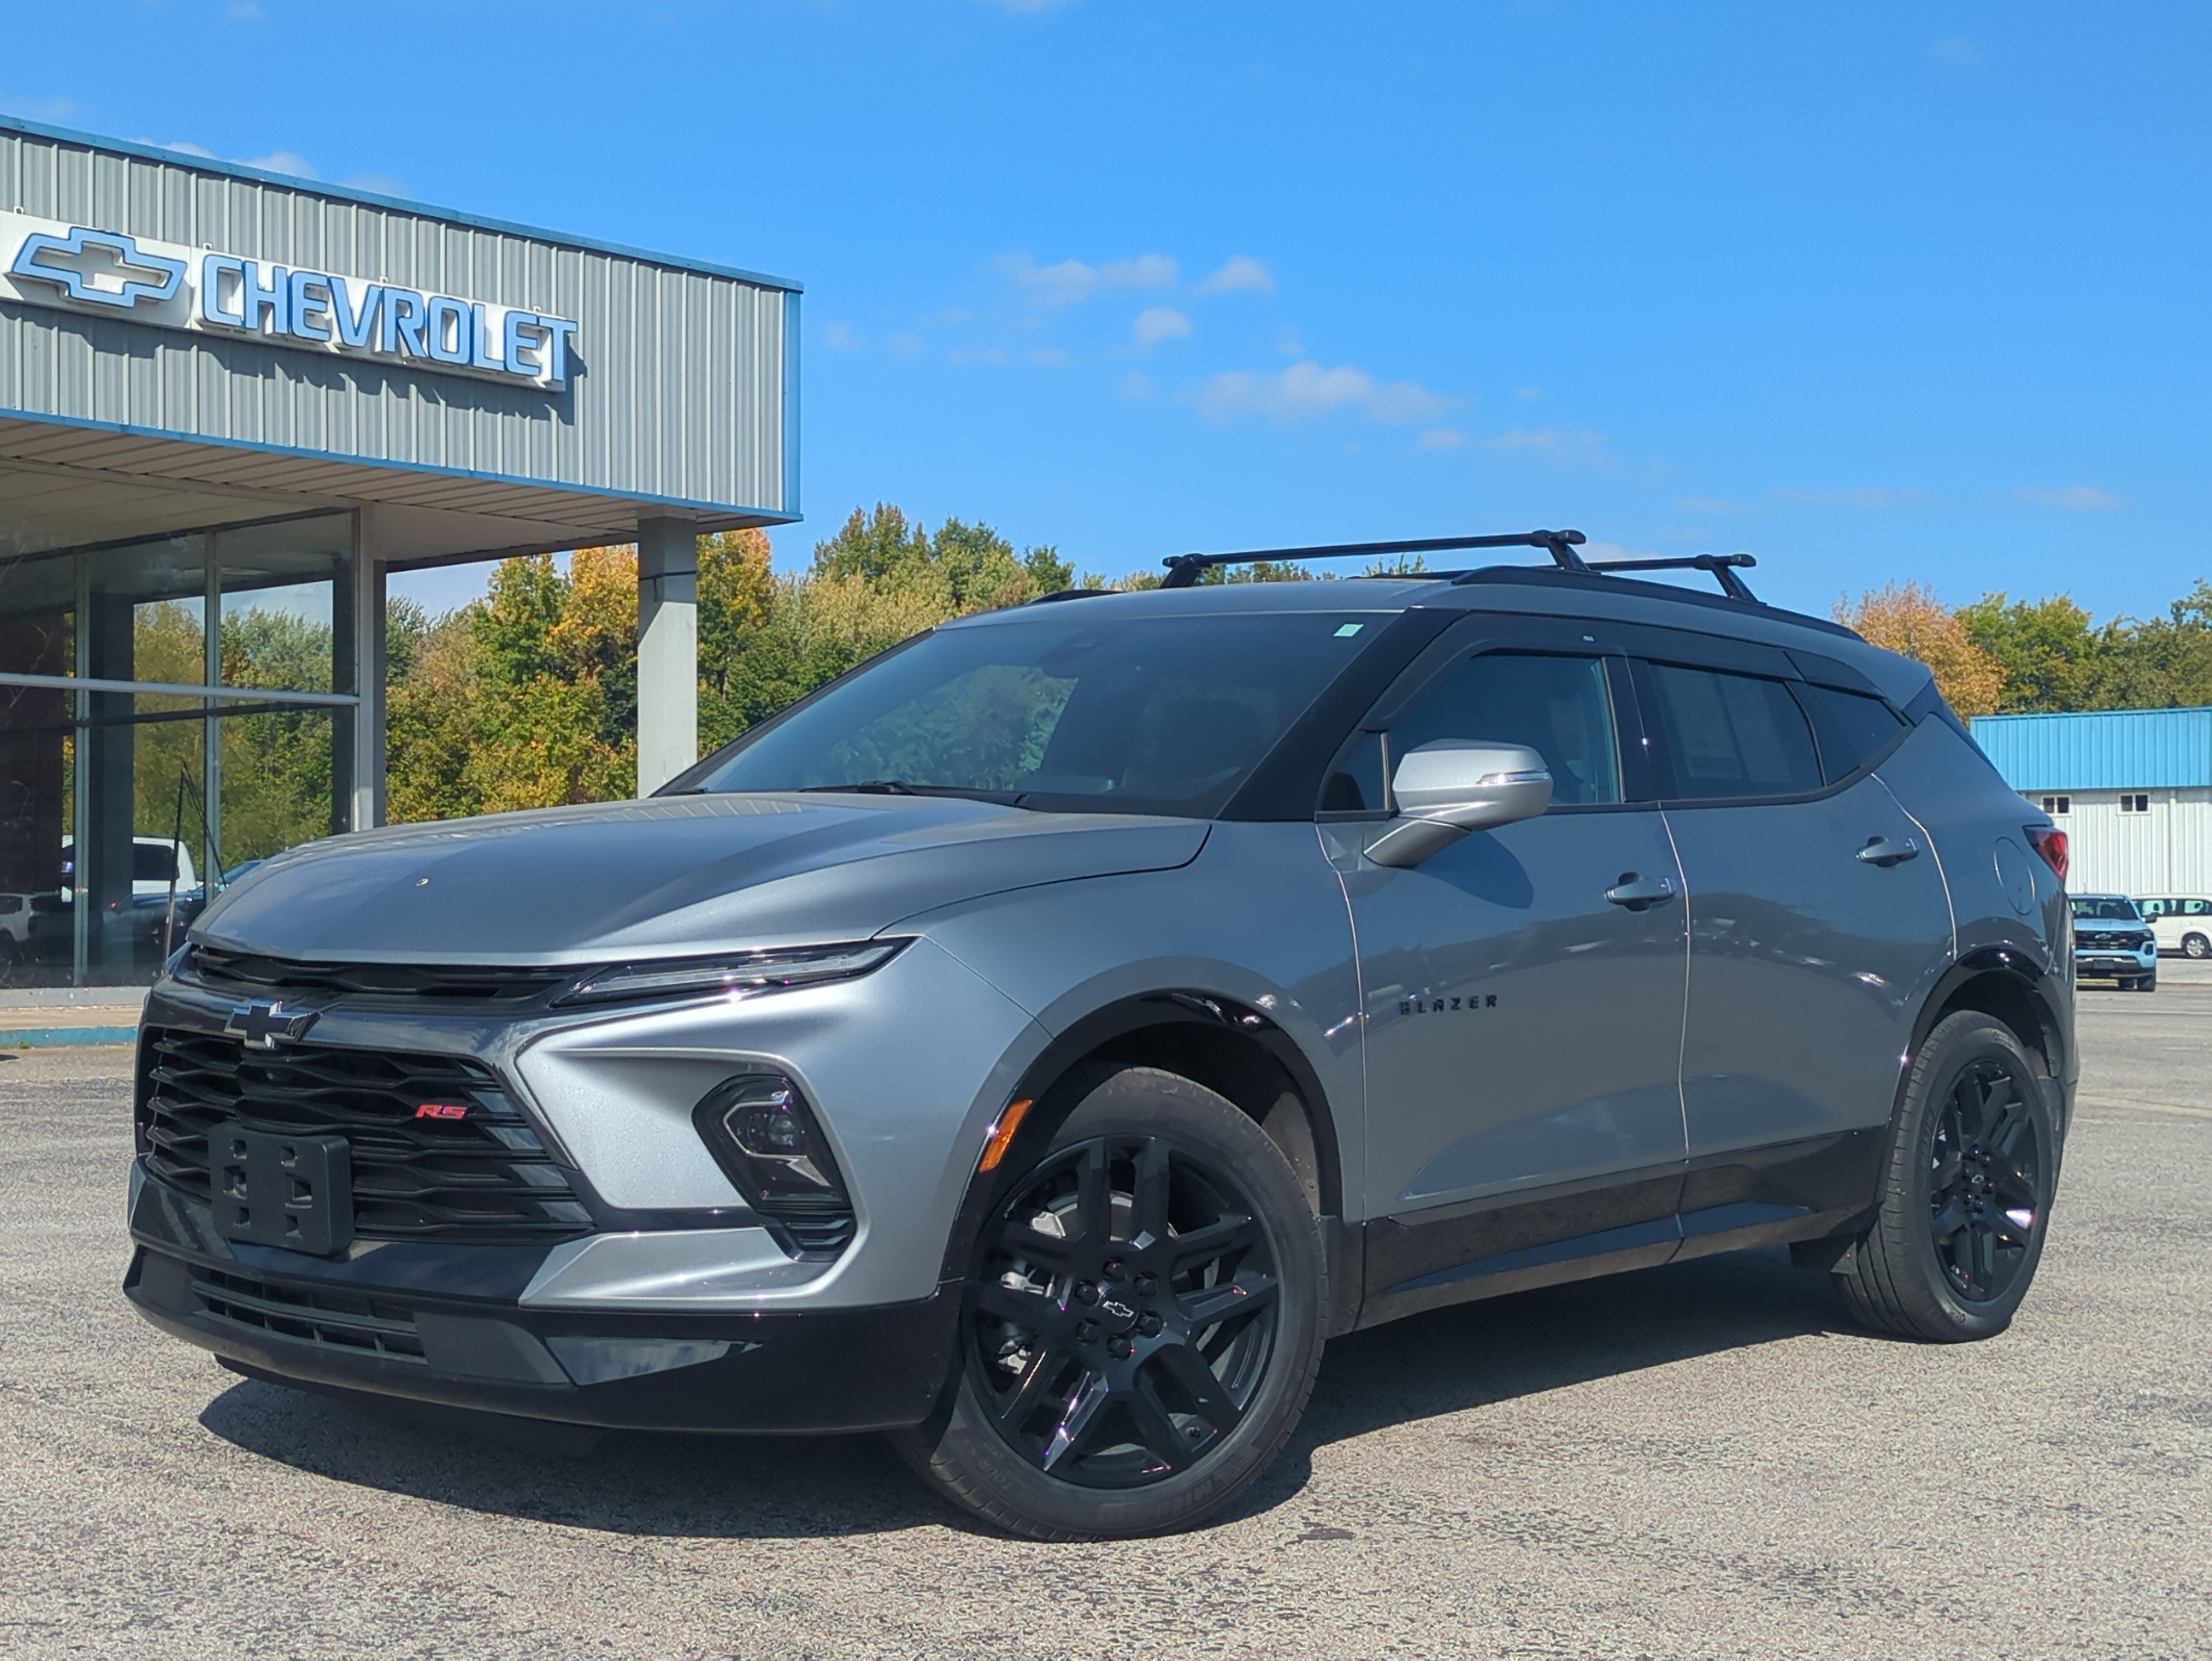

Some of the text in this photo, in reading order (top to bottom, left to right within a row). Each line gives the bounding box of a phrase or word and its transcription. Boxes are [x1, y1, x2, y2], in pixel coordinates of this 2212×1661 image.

[200, 253, 578, 382] CHEVROLET
[1399, 994, 1497, 1015] BLAZER
[415, 1104, 468, 1119] RS
